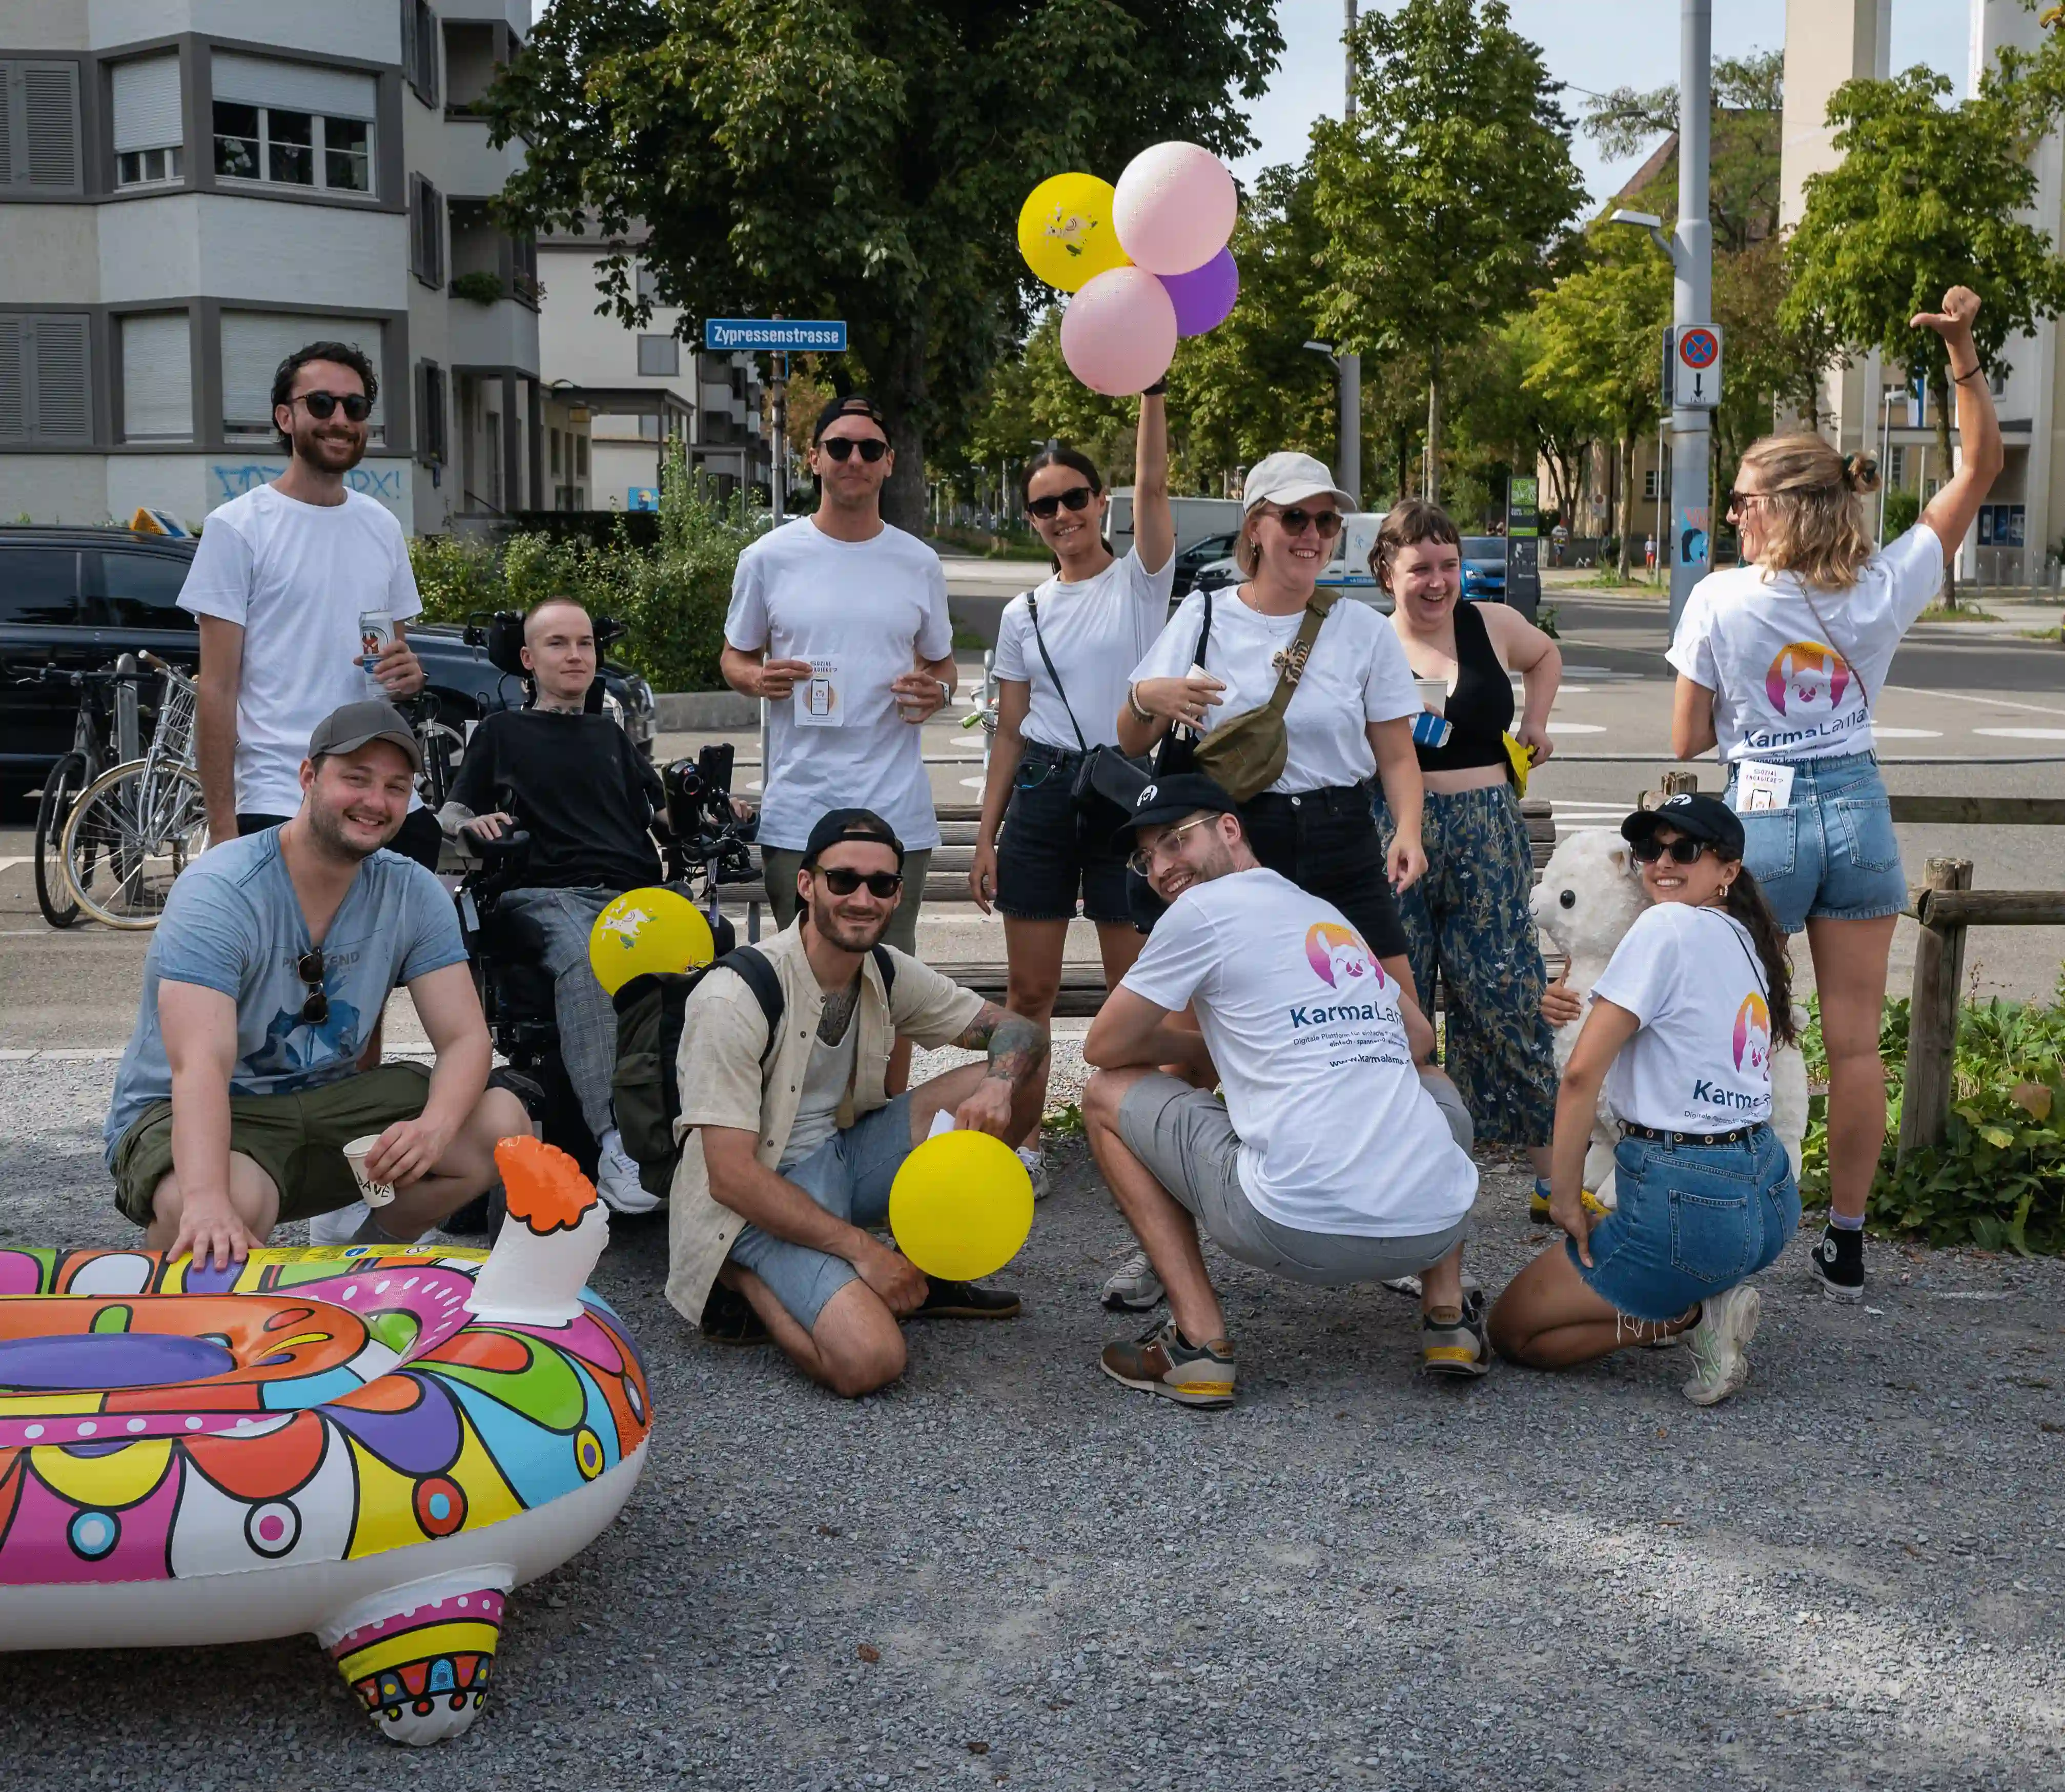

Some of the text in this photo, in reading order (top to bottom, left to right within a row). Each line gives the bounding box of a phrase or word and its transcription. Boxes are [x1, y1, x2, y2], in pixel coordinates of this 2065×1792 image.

[714, 326, 839, 345] Zypressenstrasse
[1744, 708, 1866, 747] KarmaLama
[1290, 1001, 1403, 1028] KarmaLam
[1293, 1035, 1320, 1045] Digitale
[1684, 1110, 1711, 1119] Digitale
